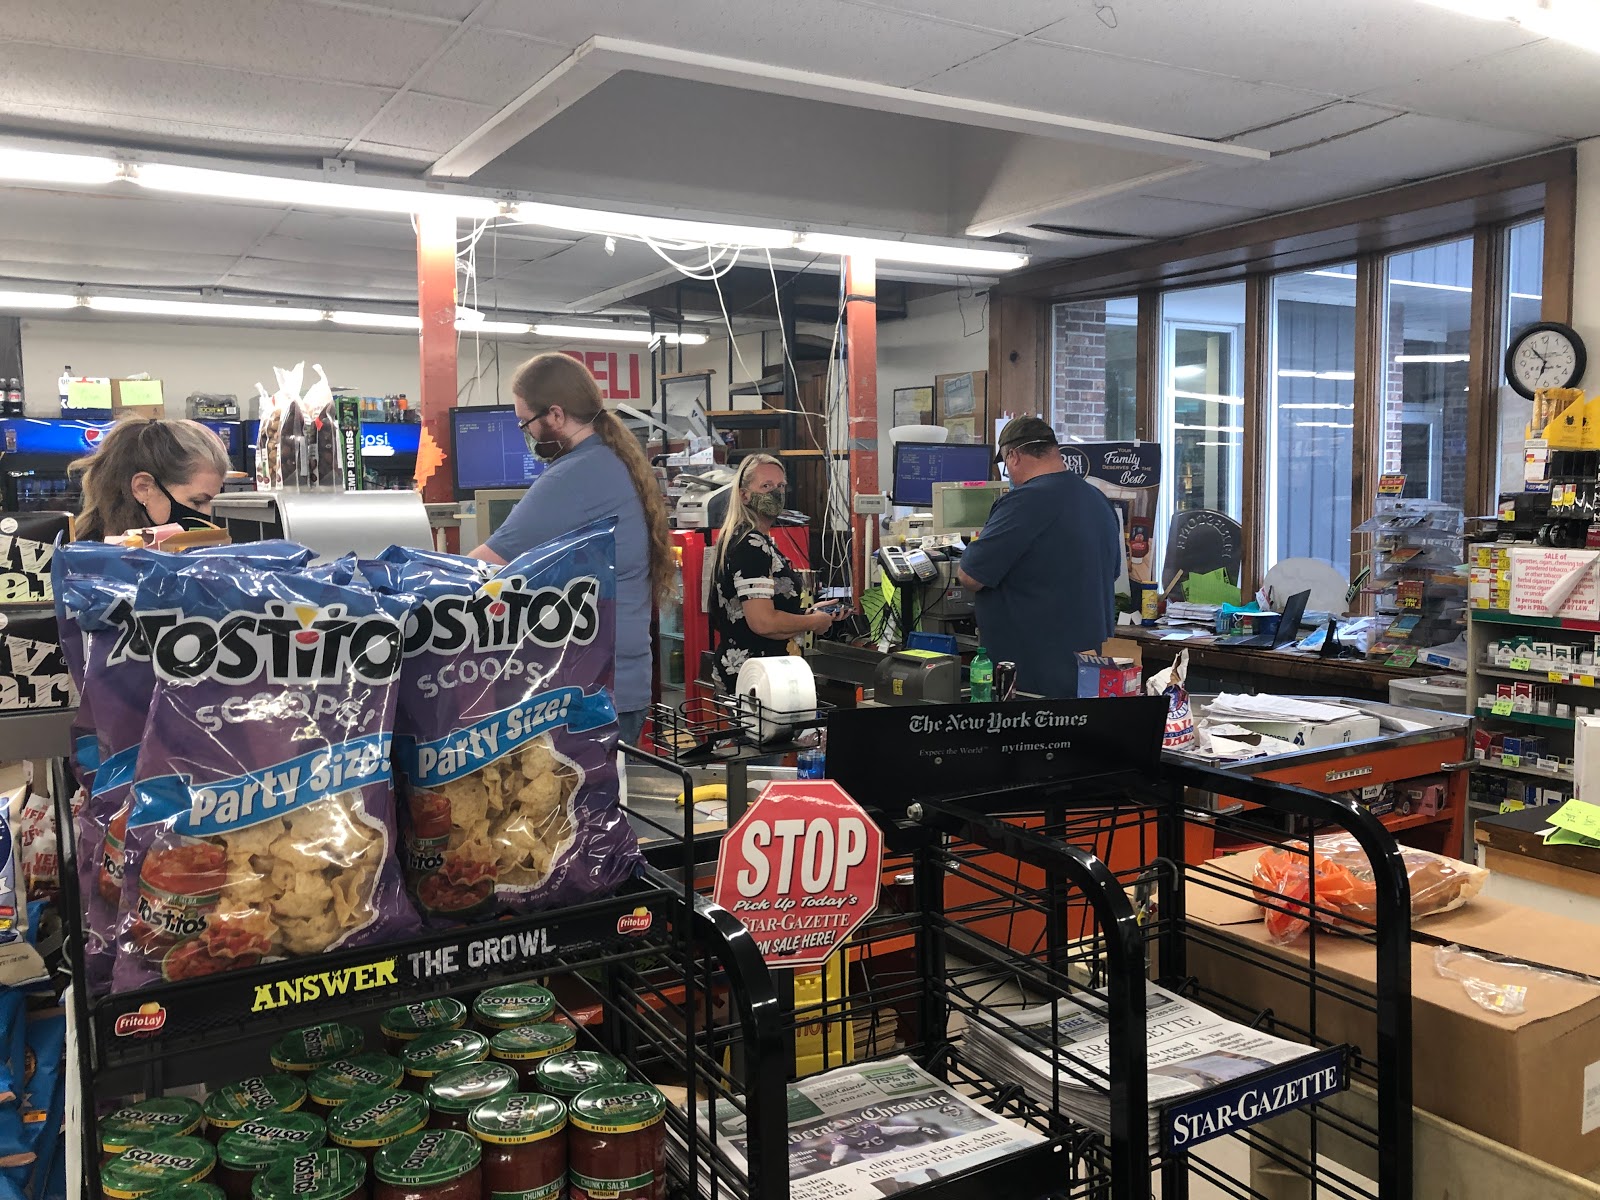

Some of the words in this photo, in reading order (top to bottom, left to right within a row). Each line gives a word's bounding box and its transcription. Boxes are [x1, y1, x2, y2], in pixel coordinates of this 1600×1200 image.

[559, 351, 640, 399] ELI
[346, 430, 355, 468] BOMBS
[361, 432, 391, 446] epsi
[1104, 451, 1140, 470] Family
[346, 468, 355, 491] EMP
[403, 576, 599, 653] OSTITOS
[136, 602, 404, 684] TOSTITO
[909, 714, 943, 734] The
[946, 713, 984, 732] New
[987, 712, 1031, 734] York
[1034, 710, 1088, 728] Times
[418, 723, 499, 778] Party
[506, 694, 572, 740] Size!
[1001, 741, 1071, 754] nytimes.com
[189, 767, 300, 826] Party
[310, 741, 392, 791] Size!
[736, 818, 867, 898] STOP
[733, 900, 770, 912] Pick
[774, 898, 796, 911] Up
[801, 894, 858, 908] Today's
[757, 940, 771, 955] ON
[772, 936, 801, 953] SALE
[802, 930, 836, 947] HERE!
[251, 957, 398, 1012] ANSWER
[408, 944, 459, 978] THE
[467, 928, 556, 968] GROWL
[1060, 1018, 1088, 1030] FREE
[1160, 1041, 1195, 1056] travel
[871, 1074, 902, 1085] 75%
[902, 1072, 919, 1083] off
[892, 1080, 917, 1089] Labor
[861, 1095, 950, 1121] Chronicle
[1174, 1066, 1337, 1146] STAR-GAZETTE
[868, 1152, 930, 1170] different
[930, 1145, 953, 1155] Eid
[956, 1130, 1007, 1150] al-Adha
[869, 1168, 897, 1178] this
[899, 1160, 930, 1172] year
[934, 1155, 953, 1163] for
[954, 1137, 1013, 1156] Muslims
[523, 1187, 549, 1200] CHUNKY
[580, 1178, 605, 1190] CHUNKY
[607, 1180, 629, 1190] SALSA
